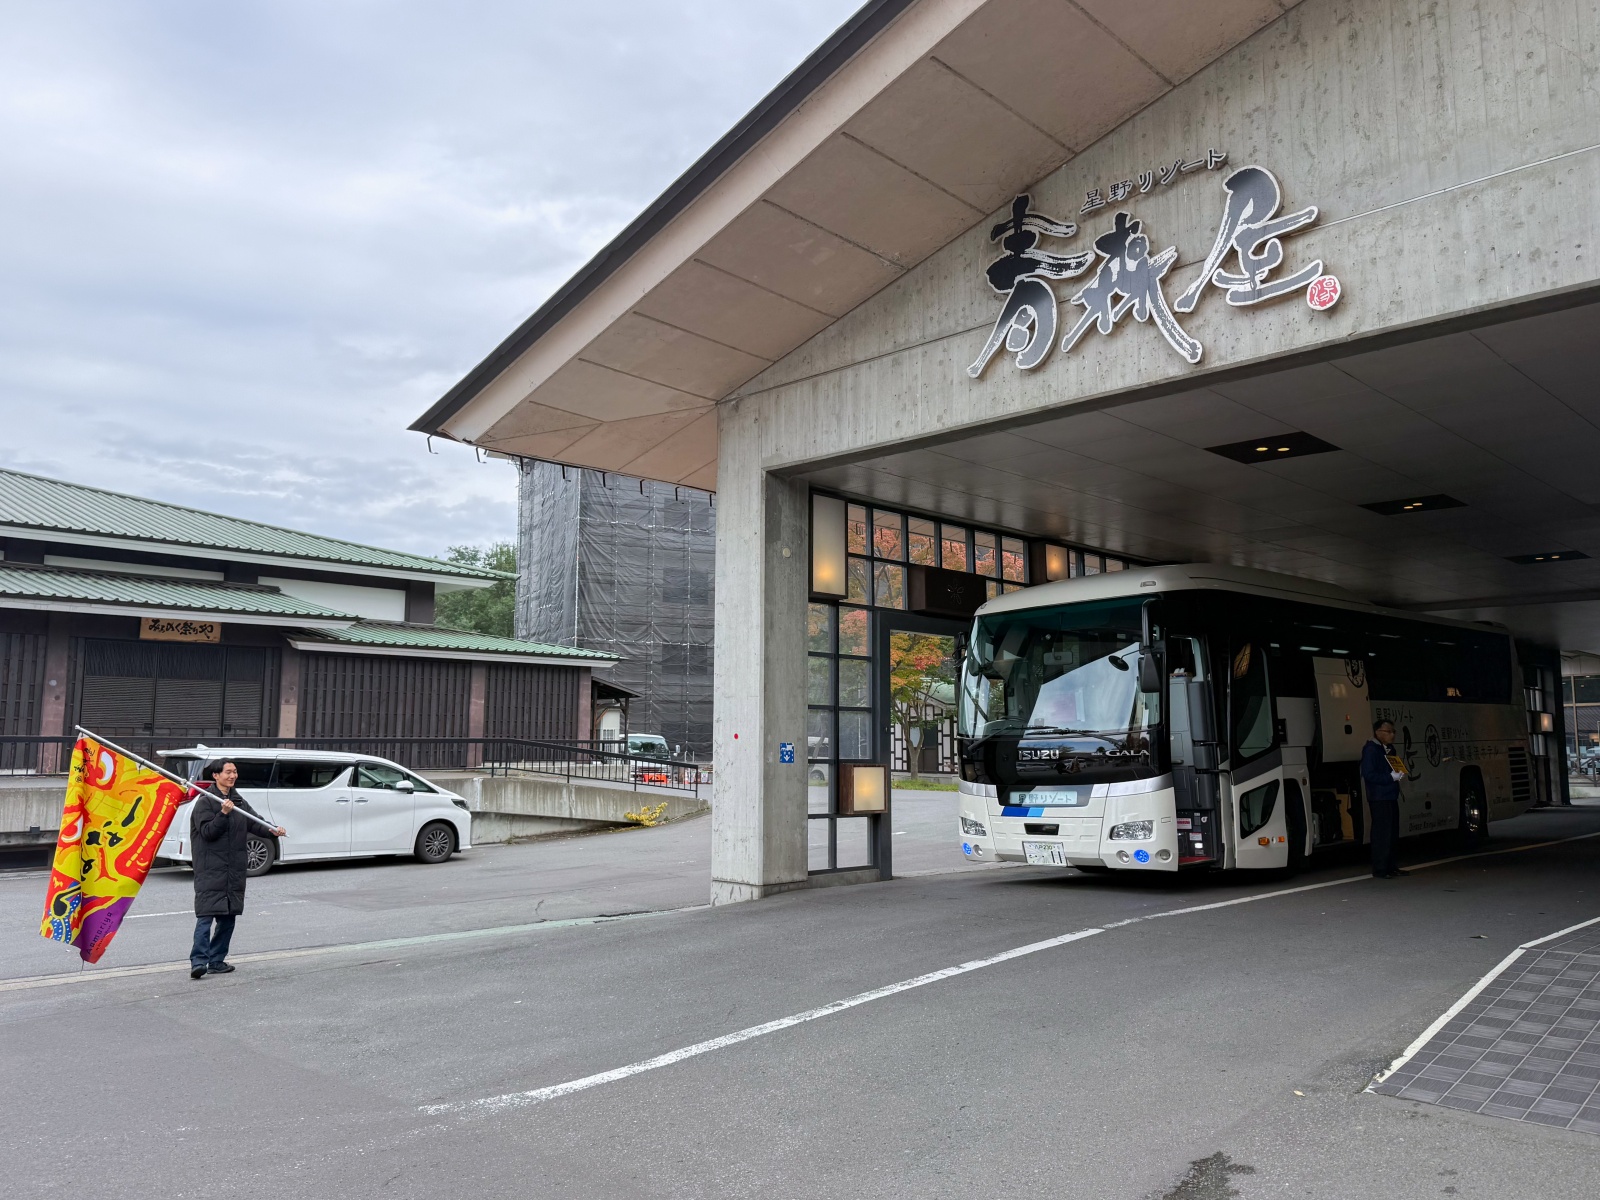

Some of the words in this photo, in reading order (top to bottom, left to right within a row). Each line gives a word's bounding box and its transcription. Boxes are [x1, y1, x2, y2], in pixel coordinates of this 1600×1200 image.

[1080, 149, 1227, 214] 星野リゾート
[1018, 750, 1060, 761] ISUZU
[1105, 749, 1150, 757] GALA
[1018, 793, 1072, 805] 星野リゾート
